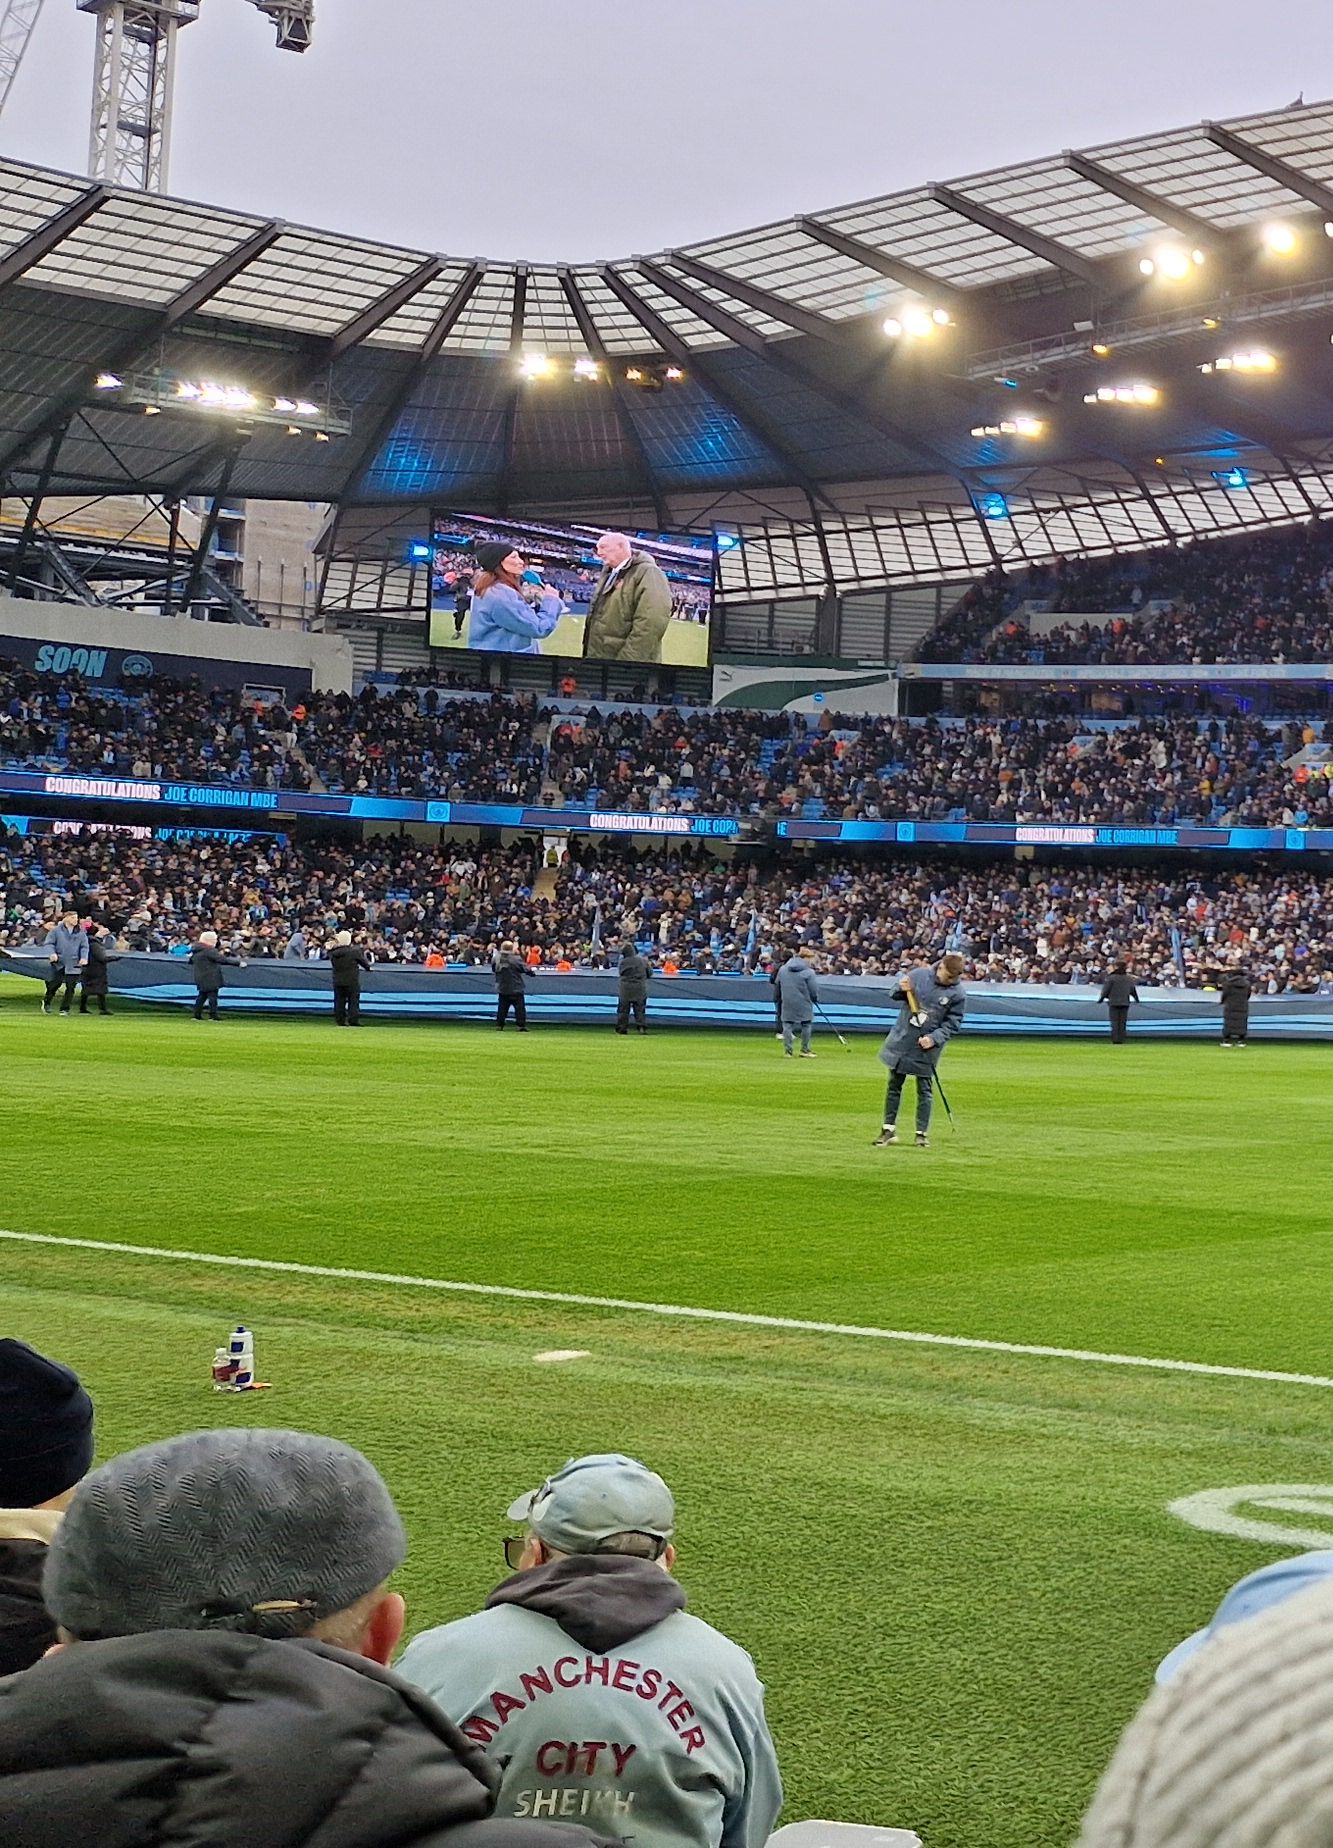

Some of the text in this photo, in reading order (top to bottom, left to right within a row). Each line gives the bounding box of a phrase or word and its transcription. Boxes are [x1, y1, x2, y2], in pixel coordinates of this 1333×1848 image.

[35, 645, 108, 678] SOON
[46, 777, 278, 808] CONGRATULATIONS JOE CORRIGAN MBE
[590, 814, 689, 832] CONGRATULATIONS
[691, 818, 711, 833] JOE
[1016, 828, 1094, 843] CONGRATULATIONS
[1096, 829, 1112, 843] JOE
[1114, 830, 1156, 844] CORRIGAN
[459, 1655, 706, 1754] MANCHESTER
[536, 1740, 637, 1777] CITY
